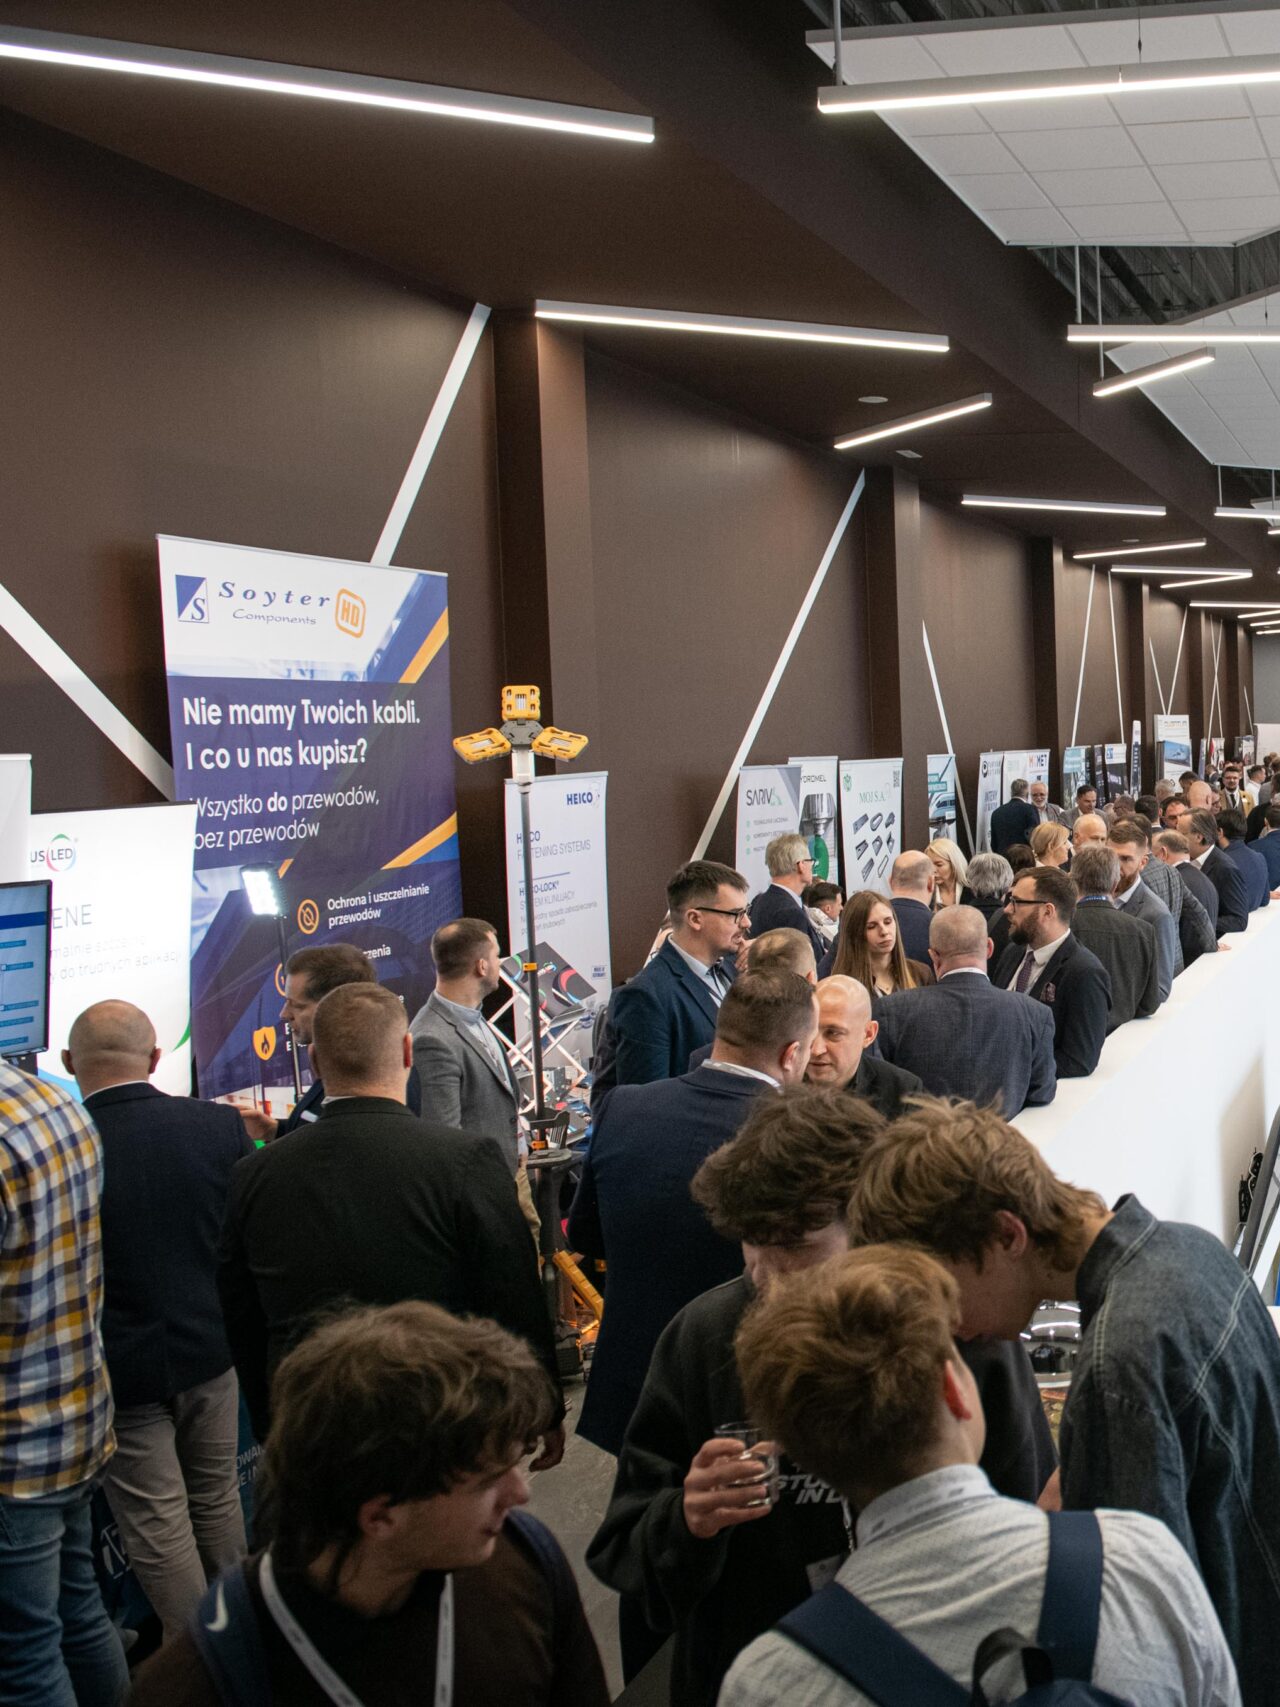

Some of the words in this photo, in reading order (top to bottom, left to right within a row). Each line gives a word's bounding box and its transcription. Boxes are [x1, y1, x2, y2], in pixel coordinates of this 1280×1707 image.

[218, 580, 331, 608] Soyter
[232, 608, 317, 626] Components
[341, 600, 360, 628] HD
[183, 697, 222, 726] Nie
[229, 702, 297, 731] mamy
[301, 699, 368, 725] Twoich
[373, 699, 421, 725] kabli.
[186, 742, 194, 771] I
[200, 747, 231, 770] co
[237, 746, 250, 769] u
[256, 745, 293, 768] nas
[298, 738, 368, 771] kupisz?
[267, 791, 288, 812] do
[292, 785, 381, 815] przewodów,
[566, 792, 594, 806] HEICO
[229, 818, 321, 851] przewodów
[516, 831, 541, 845] HCO
[51, 848, 74, 862] LED
[517, 843, 559, 861] FTENING
[559, 839, 592, 856] SYSTEMS
[327, 893, 367, 912] Ochrona
[368, 891, 373, 904] i
[373, 883, 430, 904] uszczelnianie
[328, 908, 382, 929] przewodów
[60, 964, 77, 980] do
